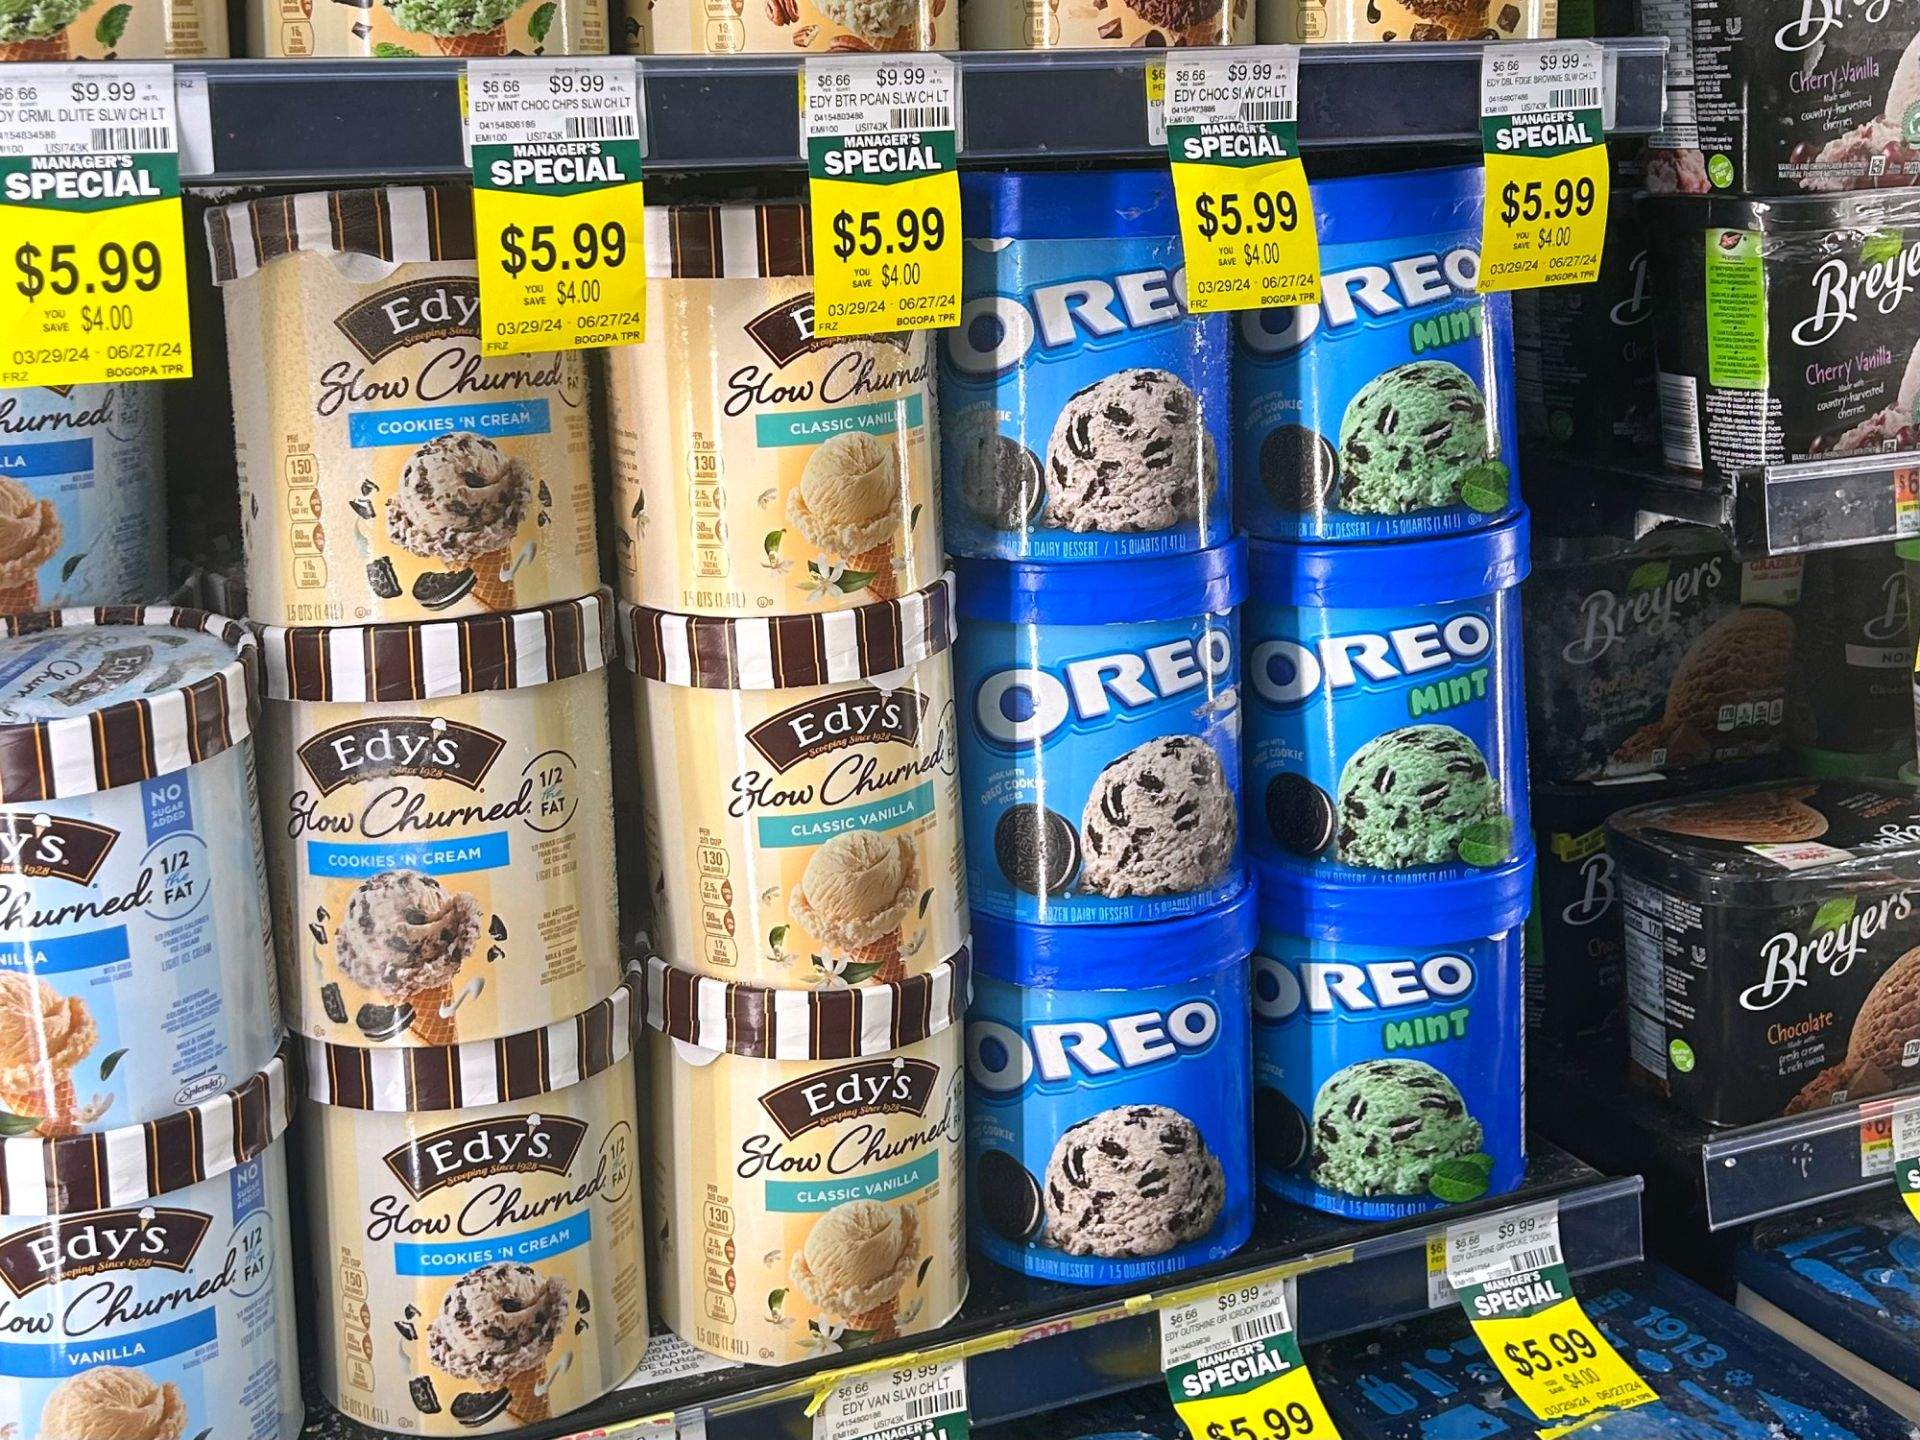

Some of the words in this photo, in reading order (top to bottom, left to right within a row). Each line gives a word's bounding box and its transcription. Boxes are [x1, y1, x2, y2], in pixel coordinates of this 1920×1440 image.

[1228, 64, 1272, 82] $9.99
[1540, 53, 1579, 71] $9.99
[1842, 56, 1880, 82] Vanilla
[549, 75, 604, 94] $9.99
[877, 68, 925, 88] $9.99
[72, 83, 135, 103] $9.99
[522, 100, 550, 110] CHOC
[553, 98, 579, 109] CHPS
[836, 94, 856, 107] BTR
[860, 93, 889, 106] PCAN
[1200, 87, 1229, 101] CHOC
[19, 109, 55, 122] CRML
[59, 109, 94, 121] DLITE
[1512, 111, 1574, 126] MANAGER'S
[1801, 98, 1872, 121] country-harvested
[1201, 123, 1266, 135] MANAGER'S
[1822, 116, 1853, 132] cherries
[844, 134, 920, 148] MANAGER'S
[1184, 135, 1287, 160] SPECIAL
[1496, 123, 1593, 150] SPECIAL
[31, 155, 133, 170] MANAGER'S
[513, 143, 601, 158] MANAGER'S
[824, 146, 942, 175] SPECIAL
[491, 156, 625, 186] SPECIAL
[5, 171, 160, 199] SPECIAL
[1501, 177, 1594, 228] $5.99
[1196, 191, 1297, 242] $5.99
[833, 207, 944, 263] $5.99
[1538, 226, 1571, 250] $4.00
[501, 221, 626, 279] $5.99
[1219, 258, 1236, 266] SAVE
[1244, 243, 1280, 267] $4.00
[15, 242, 162, 302] $5.99
[882, 262, 920, 289] $4.00
[1491, 261, 1538, 275] 03/29/24
[1550, 254, 1597, 268] 06/27/24
[525, 285, 543, 293] YOU
[557, 279, 600, 307] $4.00
[853, 280, 872, 288] SAVE
[1198, 279, 1250, 294] 03/29/24
[1263, 274, 1314, 288] 06/27/24
[523, 297, 546, 306] SAVE
[828, 301, 885, 316] 03/29/24
[899, 295, 955, 310] 06/27/24
[1299, 292, 1314, 301] TPR
[44, 310, 66, 319] YOU
[81, 305, 132, 333] $4.00
[497, 317, 562, 336] 03/29/24
[577, 312, 640, 329] 06/27/24
[819, 322, 838, 331] FRZ
[938, 313, 955, 322] TPR
[43, 322, 69, 332] SAVE
[1411, 306, 1486, 352] MINT
[487, 341, 508, 351] FRZ
[575, 333, 618, 344] BOGOPA
[621, 331, 640, 341] TPR
[13, 347, 90, 365] 03/29/24
[107, 343, 182, 359] 06/27/24
[1805, 360, 1852, 386] Cherry
[1855, 345, 1892, 372] Vanilla
[106, 366, 157, 378] BOGOPA
[160, 364, 183, 375] TPR
[317, 360, 410, 417] Slow
[415, 347, 562, 401] Churned
[724, 365, 814, 417] Slow
[820, 351, 929, 404] Churned
[1817, 383, 1885, 411] country-harvested
[377, 417, 454, 435] COOKIES
[480, 411, 531, 427] CREAM
[1837, 405, 1866, 419] cherries
[790, 418, 853, 434] CLASSIC
[290, 459, 312, 475] 150
[694, 456, 715, 470] 130
[1336, 522, 1370, 537] DESSERT
[1400, 517, 1432, 534] QUARTS
[1034, 541, 1060, 557] DAIRY
[1063, 541, 1099, 557] DESSERT
[1129, 536, 1160, 553] QUARTS
[1561, 554, 1722, 664] Breyers
[1252, 616, 1489, 702] OREO
[978, 630, 1231, 742] OREO
[1411, 669, 1488, 715] MINT
[788, 702, 901, 748] Edy's
[330, 729, 459, 770] Edy's
[539, 767, 563, 787] 1/2
[728, 771, 813, 818] Slow
[820, 730, 944, 806] Churned
[151, 784, 182, 806] NO
[541, 798, 565, 816] FAT
[151, 802, 183, 818] SUGAR
[151, 810, 186, 829] ADDED
[287, 790, 354, 839] Slow
[360, 778, 533, 838] Churned
[791, 817, 855, 837] CLASSIC
[861, 800, 914, 825] VANILLA
[161, 850, 189, 875] 1/2
[328, 854, 395, 868] COOKIES
[423, 847, 481, 864] CREAM
[703, 850, 723, 866] 130
[164, 881, 194, 905] FAT
[1739, 887, 1912, 1010] Breyers
[1253, 956, 1472, 1018] OREO
[1385, 1010, 1470, 1050] MINT
[1767, 1011, 1833, 1044] Chocolate
[967, 1002, 1216, 1091] OREO
[801, 1073, 912, 1117] Edy's
[820, 1107, 859, 1127] Scooping
[610, 1136, 625, 1158] 1/2
[737, 1134, 820, 1178] Slow
[827, 1099, 950, 1175] Churned
[426, 1130, 552, 1177] Edy's
[237, 1163, 258, 1187] NO
[447, 1167, 488, 1186] Scooping
[611, 1172, 627, 1189] FAT
[796, 1187, 859, 1204] CLASSIC
[865, 1170, 919, 1196] VANILLA
[367, 1195, 450, 1241] Slow
[457, 1153, 606, 1237] Churned
[709, 1206, 729, 1224] 130
[1363, 1202, 1396, 1217] QUARTS
[242, 1227, 263, 1251] 1/2
[1499, 1218, 1535, 1239] $9.99
[27, 1225, 168, 1272] Edy's
[420, 1250, 493, 1266] COOKIES
[518, 1229, 570, 1254] CREAM
[244, 1256, 265, 1282] FAT
[344, 1272, 363, 1287] 150
[1060, 1262, 1094, 1279] DESSERT
[1123, 1261, 1155, 1279] QUARTS
[64, 1247, 236, 1337] Churned
[1219, 1286, 1259, 1311] $9.99
[1474, 1280, 1562, 1316] SPECIAL
[1180, 1318, 1215, 1337] OUTSHINE
[68, 1343, 146, 1365] VANILLA
[1197, 1341, 1265, 1369] MANAGER'S
[1504, 1328, 1597, 1380] $5.99
[650, 1367, 672, 1377] 200
[675, 1361, 700, 1373] LBS
[1182, 1350, 1291, 1396] SPECIAL
[843, 1402, 864, 1416] EDY
[868, 1395, 890, 1409] VAN
[893, 1387, 917, 1401] SLW
